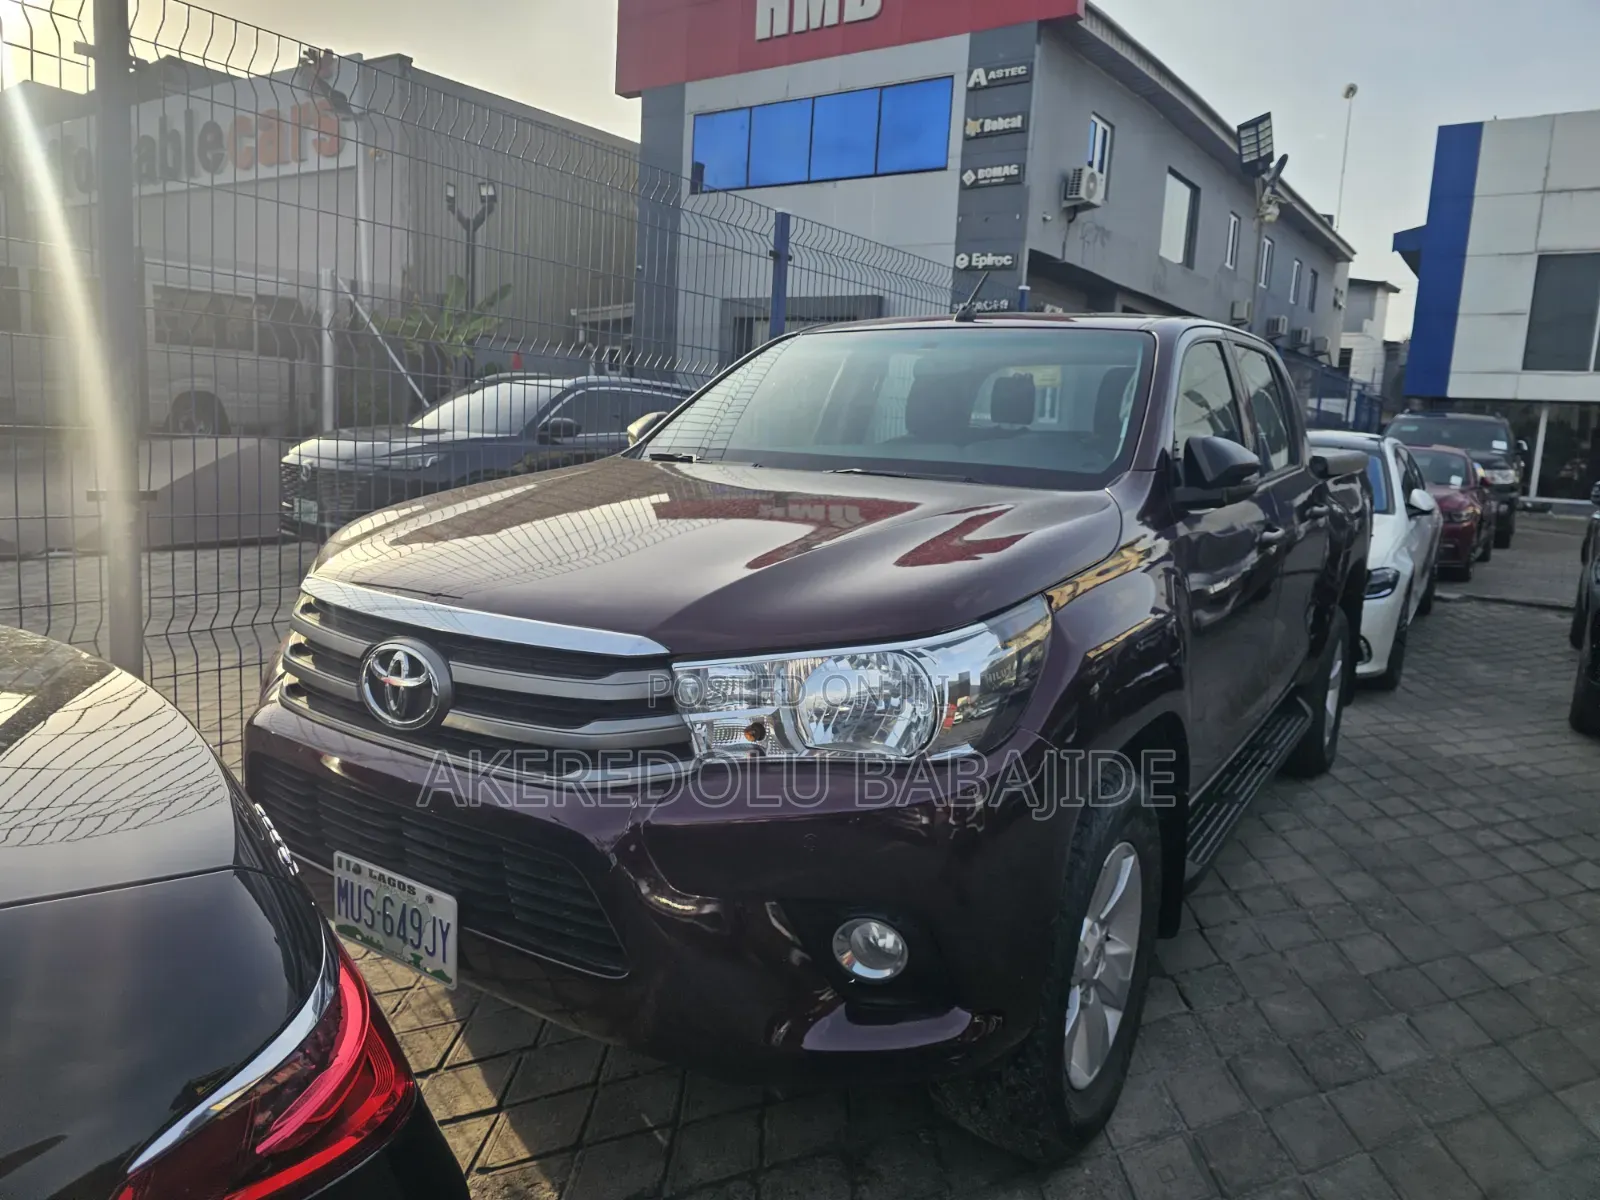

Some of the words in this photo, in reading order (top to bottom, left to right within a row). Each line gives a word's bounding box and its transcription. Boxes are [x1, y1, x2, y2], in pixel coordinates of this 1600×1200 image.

[988, 65, 1028, 80] ASTEC
[983, 115, 1023, 132] Bobcat
[977, 164, 1019, 180] BOMAG
[971, 253, 1013, 268] Epiroc
[368, 868, 417, 896] LAGOS
[337, 876, 451, 964] MUS-649JY
